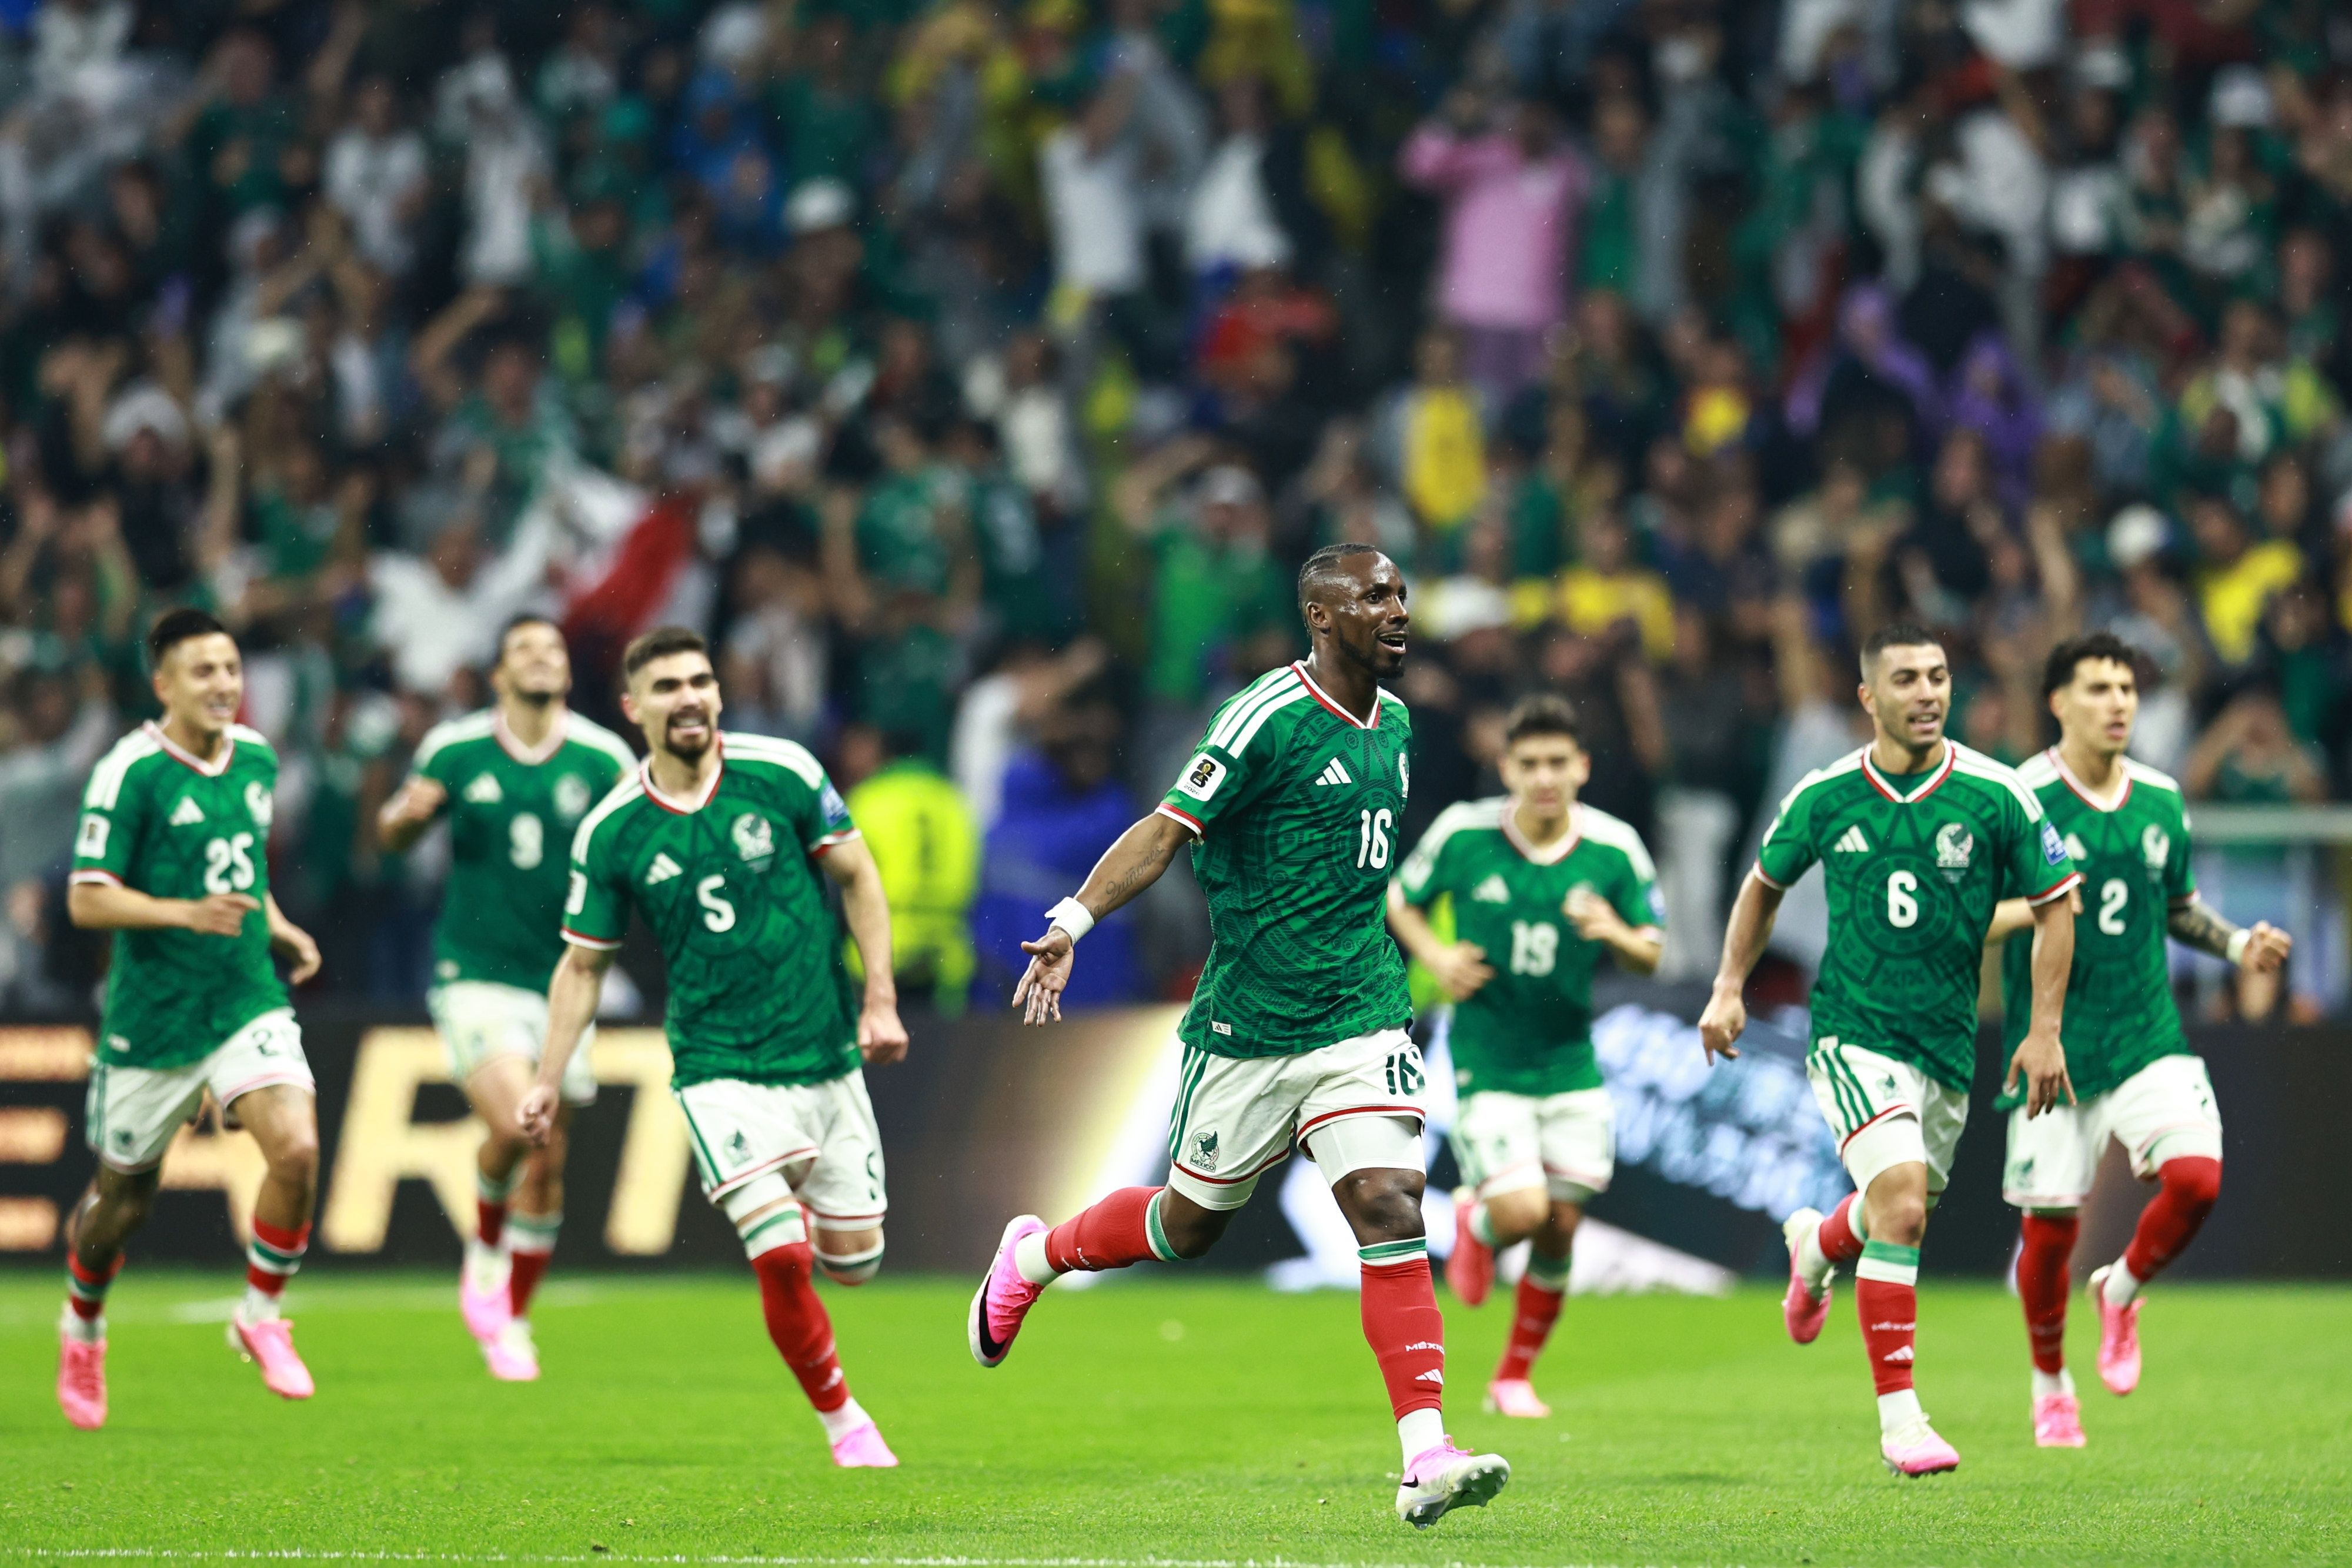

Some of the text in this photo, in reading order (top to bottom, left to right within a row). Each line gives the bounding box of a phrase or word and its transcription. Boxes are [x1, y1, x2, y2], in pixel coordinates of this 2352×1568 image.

[203, 831, 255, 894] 25
[509, 812, 544, 870] 9
[1357, 808, 1392, 870] 16
[696, 873, 736, 934] 5
[1887, 870, 1918, 928] 6
[2098, 877, 2129, 936] 2
[1509, 919, 1559, 977] 19
[1386, 1051, 1426, 1097] 16
